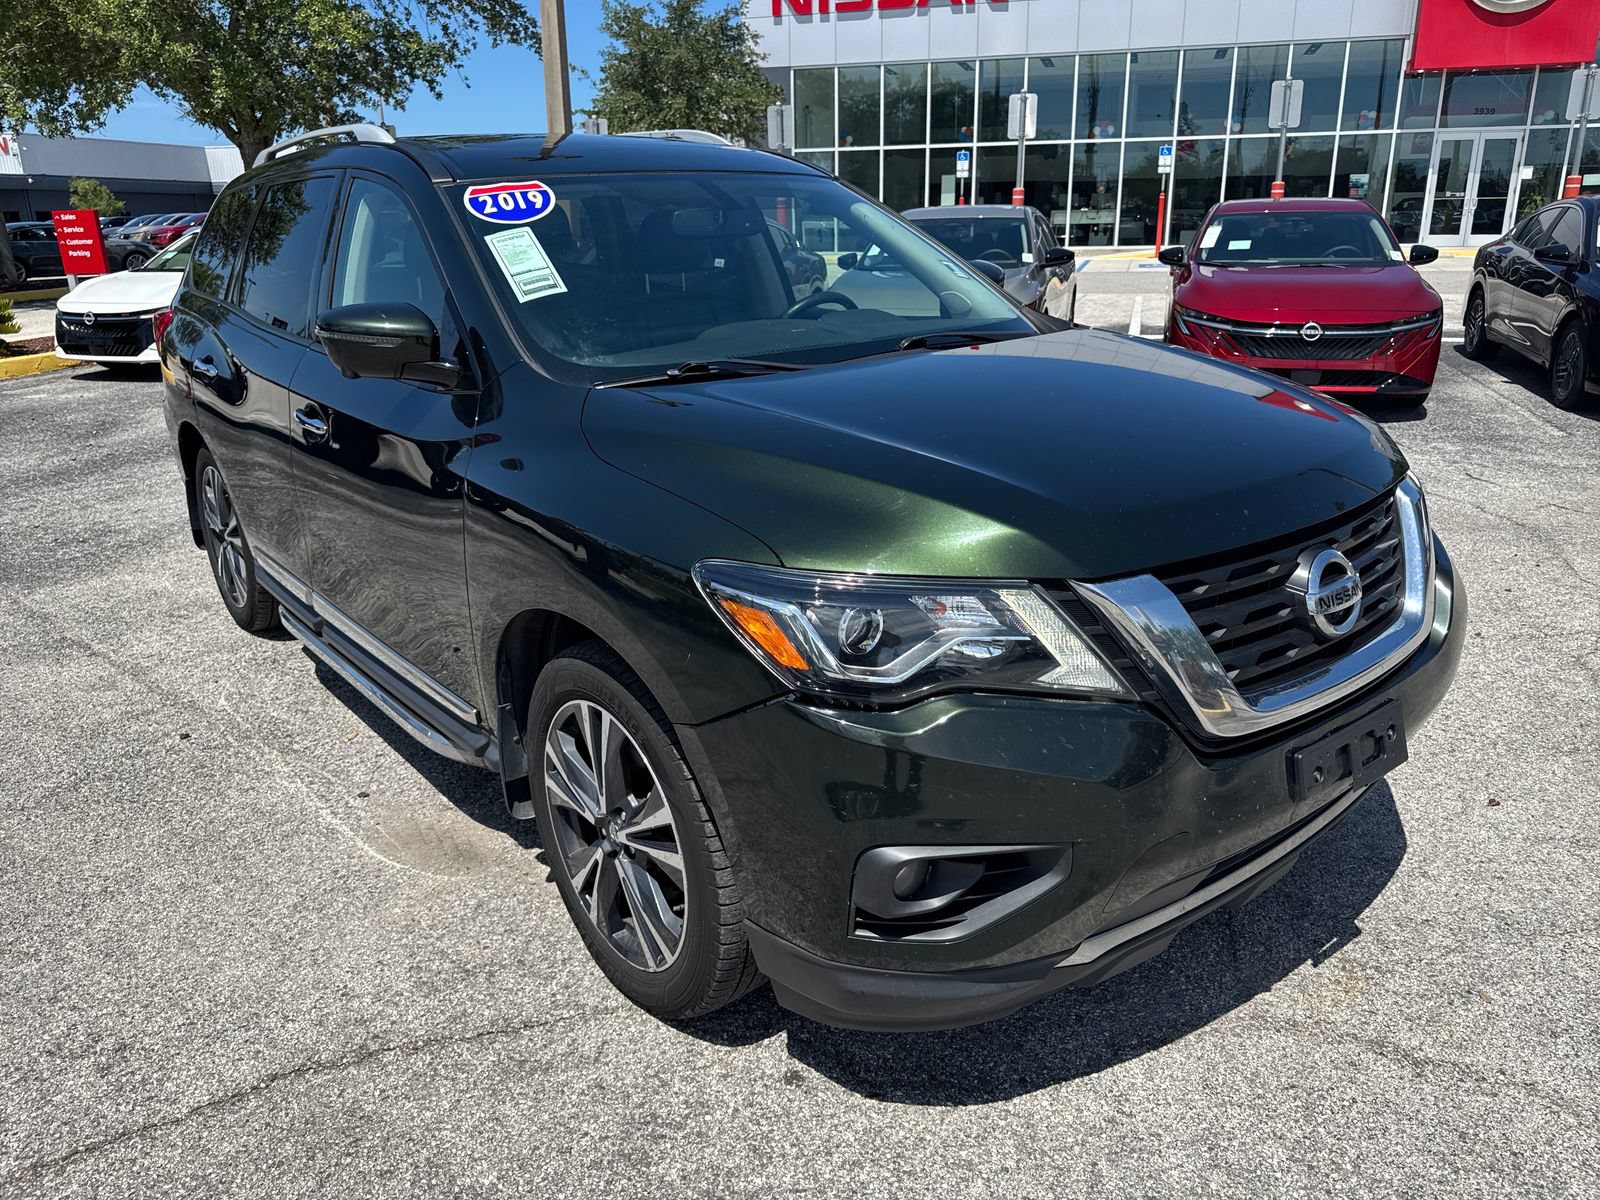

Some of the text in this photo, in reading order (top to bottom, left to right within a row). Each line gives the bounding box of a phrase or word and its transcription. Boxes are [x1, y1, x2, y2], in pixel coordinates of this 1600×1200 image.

[1473, 107, 1496, 115] 3939
[479, 191, 543, 214] 2019
[60, 213, 77, 221] Sales
[63, 226, 85, 234] Service
[68, 250, 91, 258] Parking
[1318, 583, 1362, 610] NISSAN
